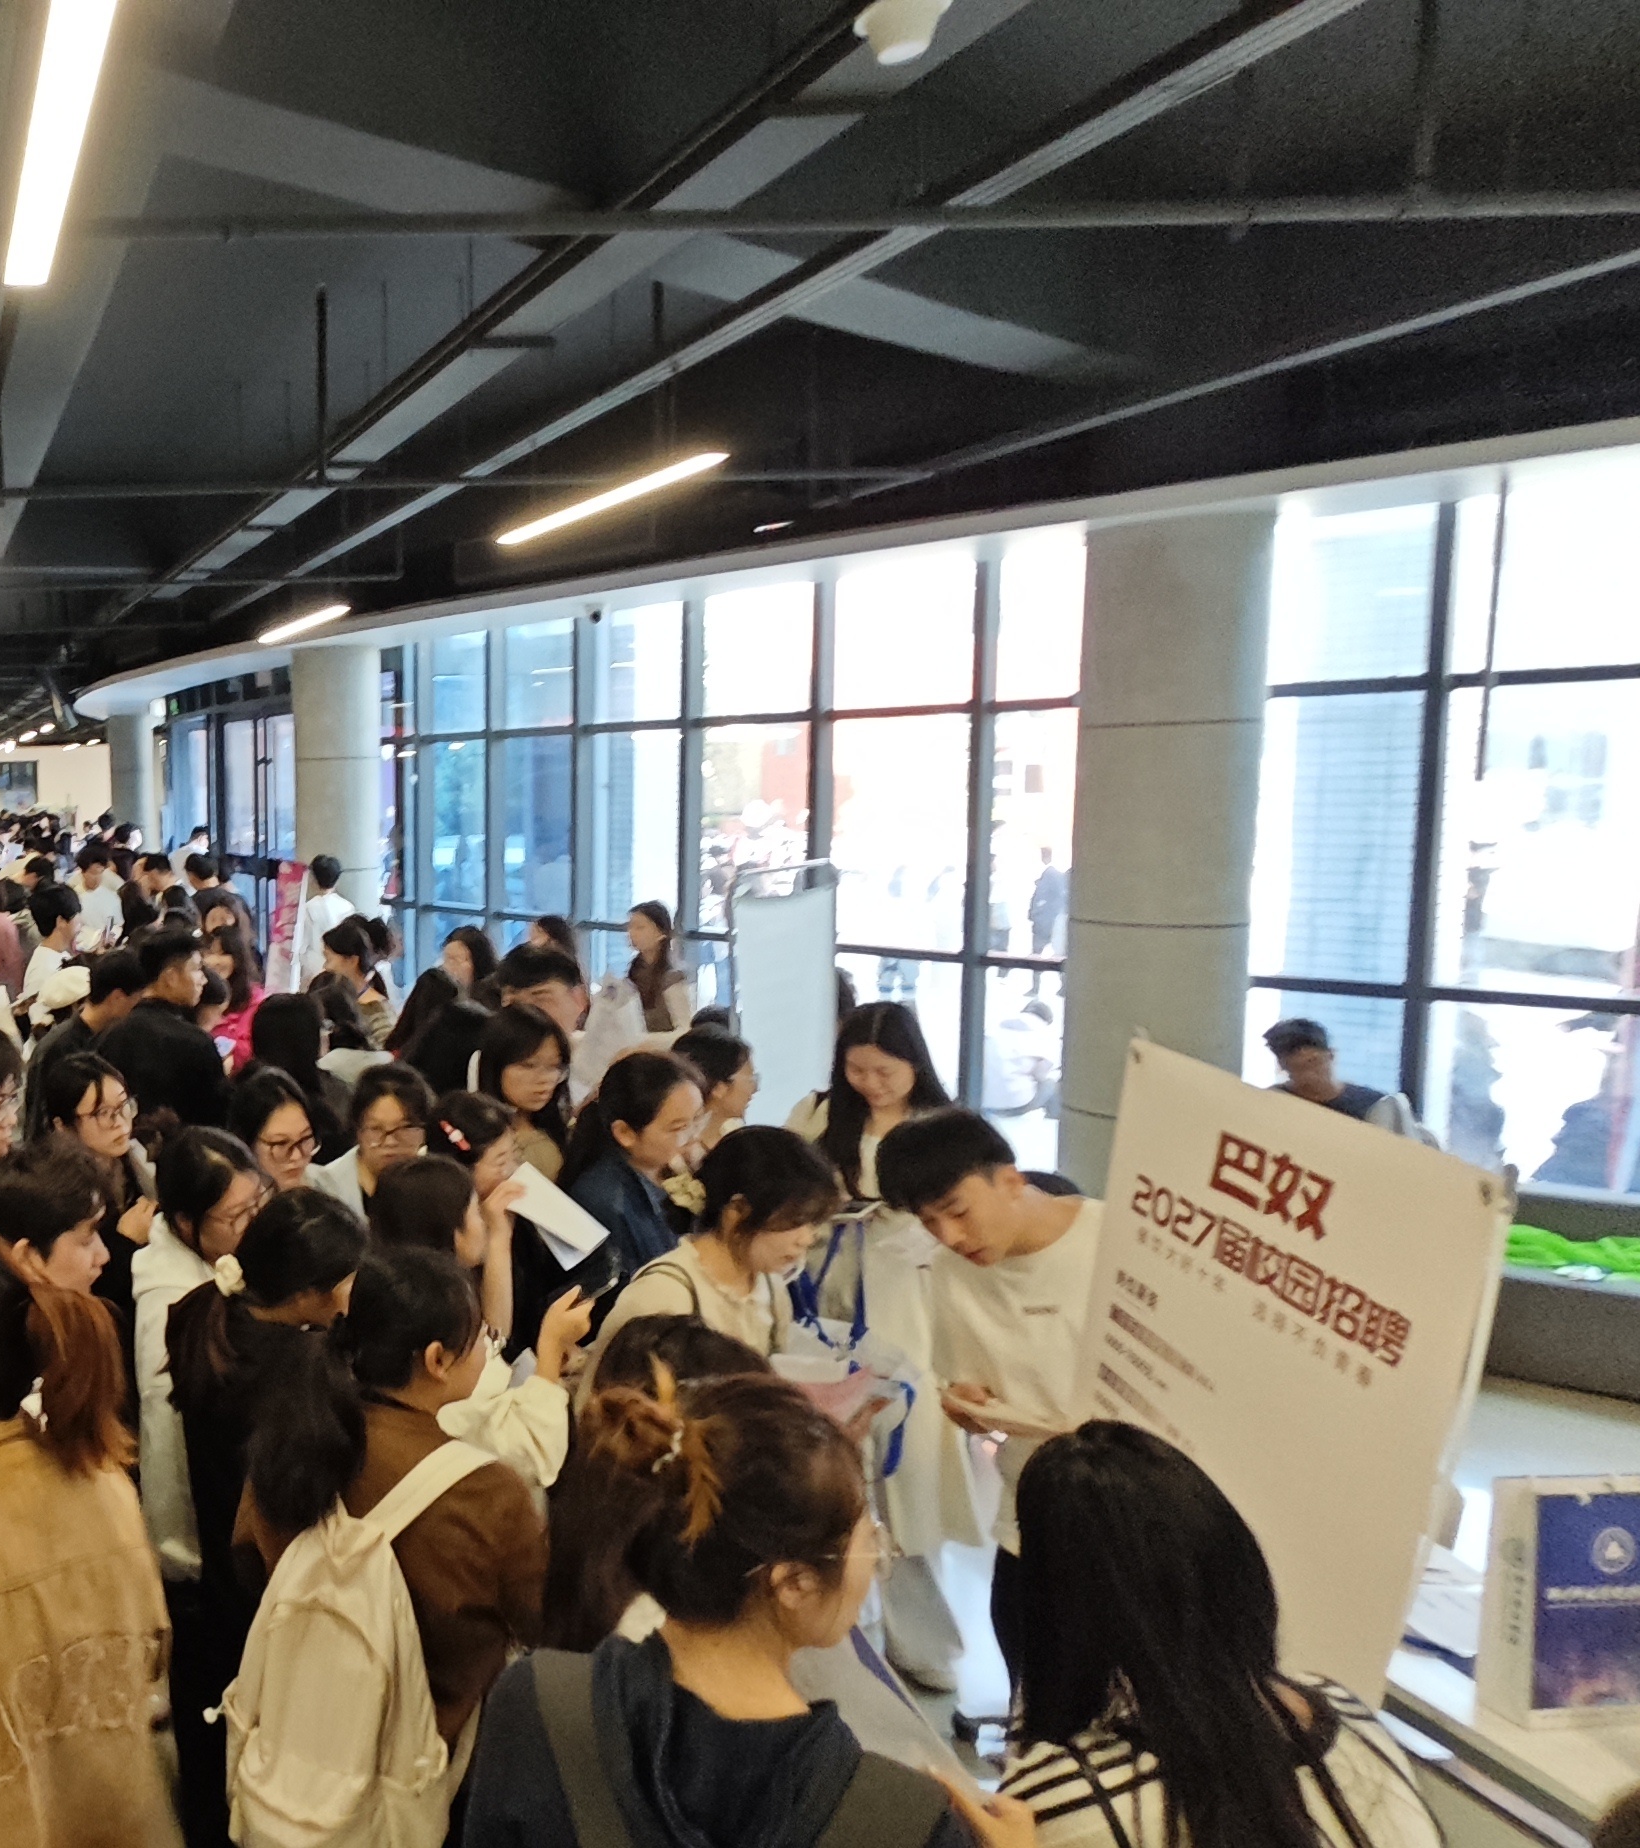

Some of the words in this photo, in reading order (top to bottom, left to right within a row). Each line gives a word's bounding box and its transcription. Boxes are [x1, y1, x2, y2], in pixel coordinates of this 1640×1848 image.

[1210, 1132, 1336, 1241] 巴奴
[1131, 1174, 1412, 1368] 2027届校园招聘
